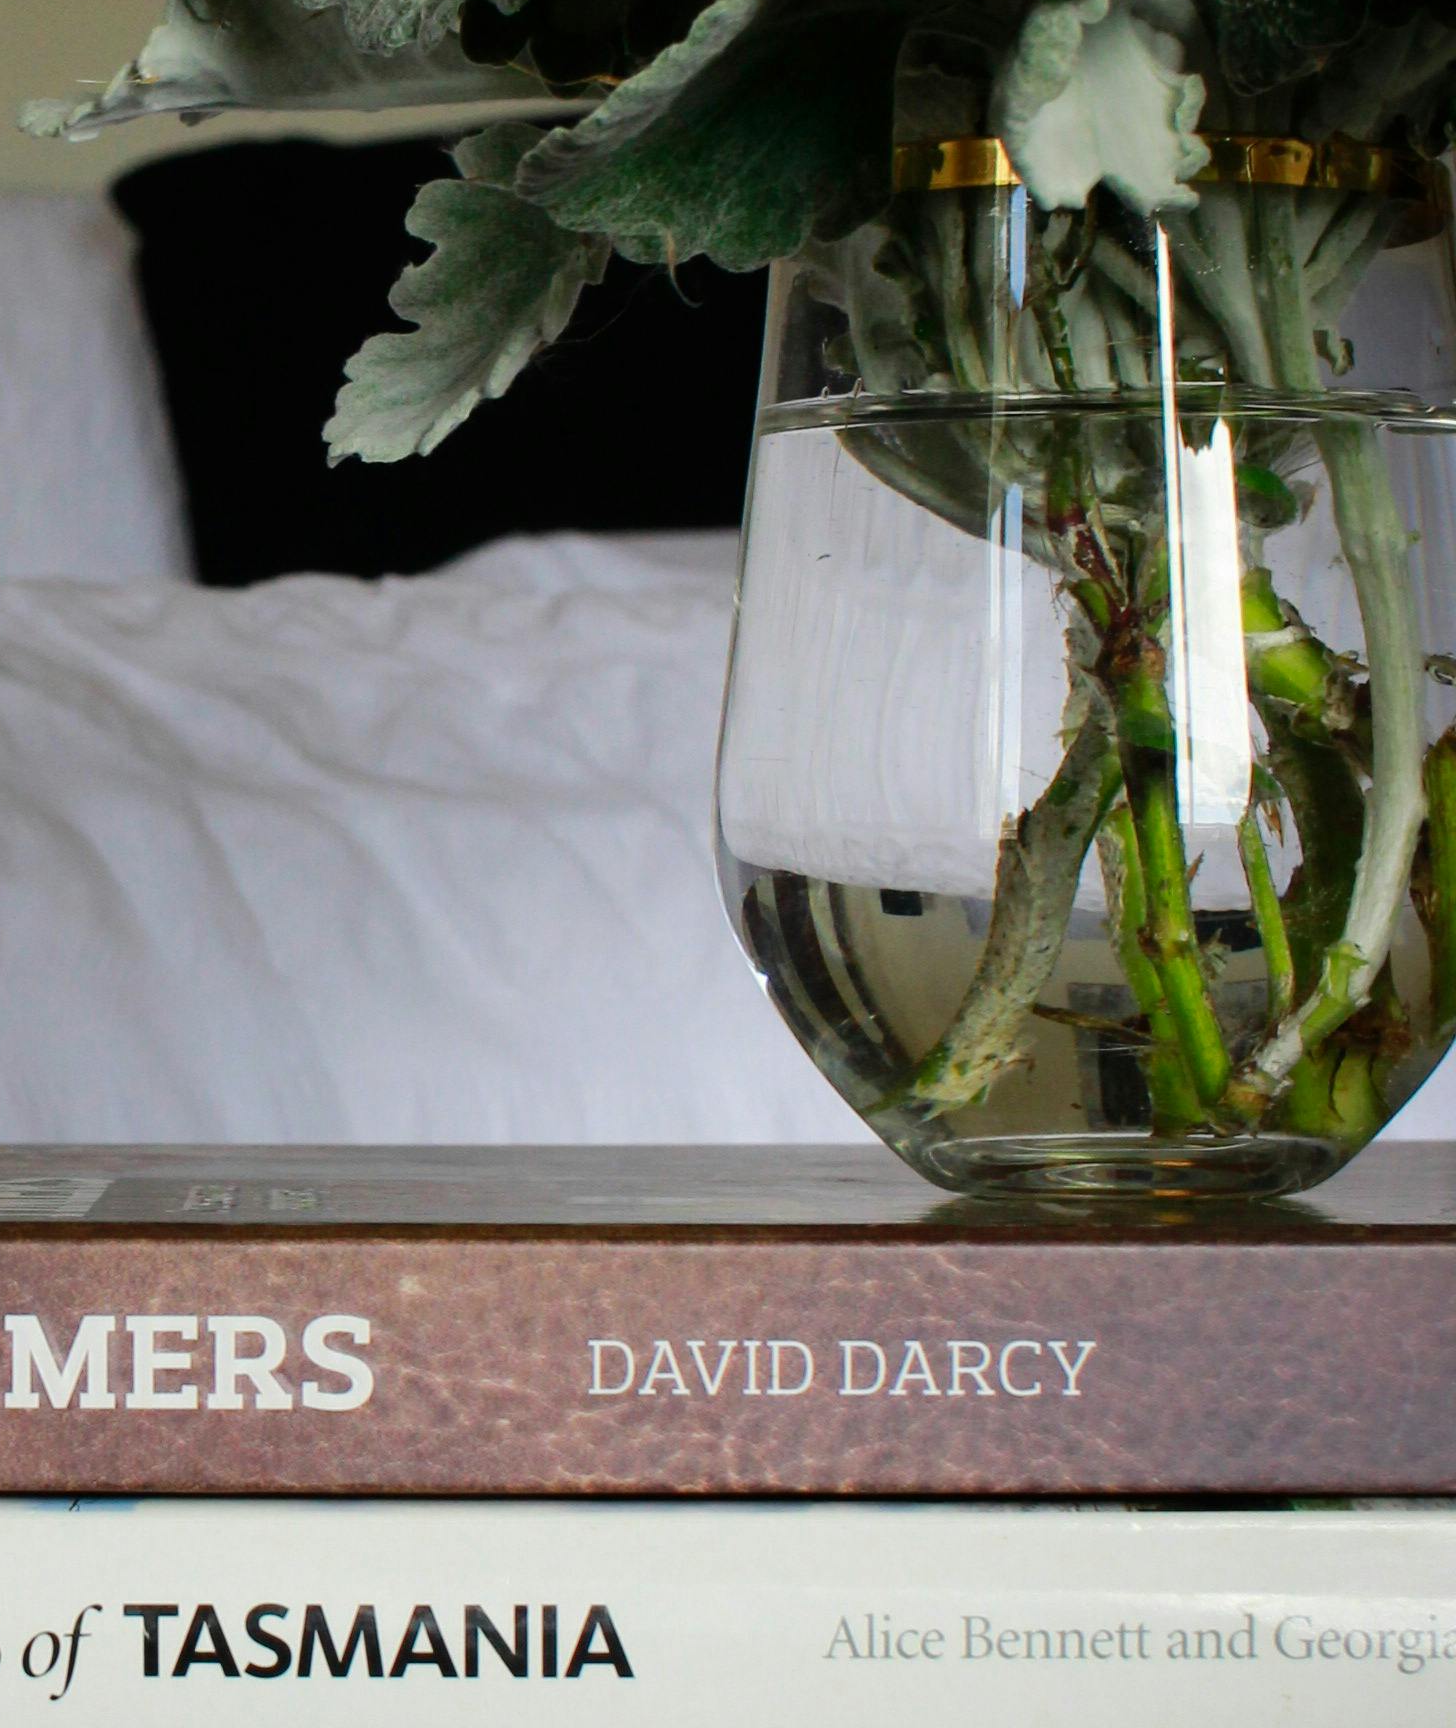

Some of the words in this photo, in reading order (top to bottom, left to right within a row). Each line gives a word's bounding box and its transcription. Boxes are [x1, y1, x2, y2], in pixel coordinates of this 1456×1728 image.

[587, 1339, 815, 1396] DAVID
[838, 1340, 1098, 1396] DARCY
[21, 1604, 105, 1702] of
[122, 1603, 636, 1679] TASMANIA
[823, 1613, 946, 1660] Alice
[960, 1616, 1151, 1660] Bennett
[1165, 1613, 1259, 1660] and
